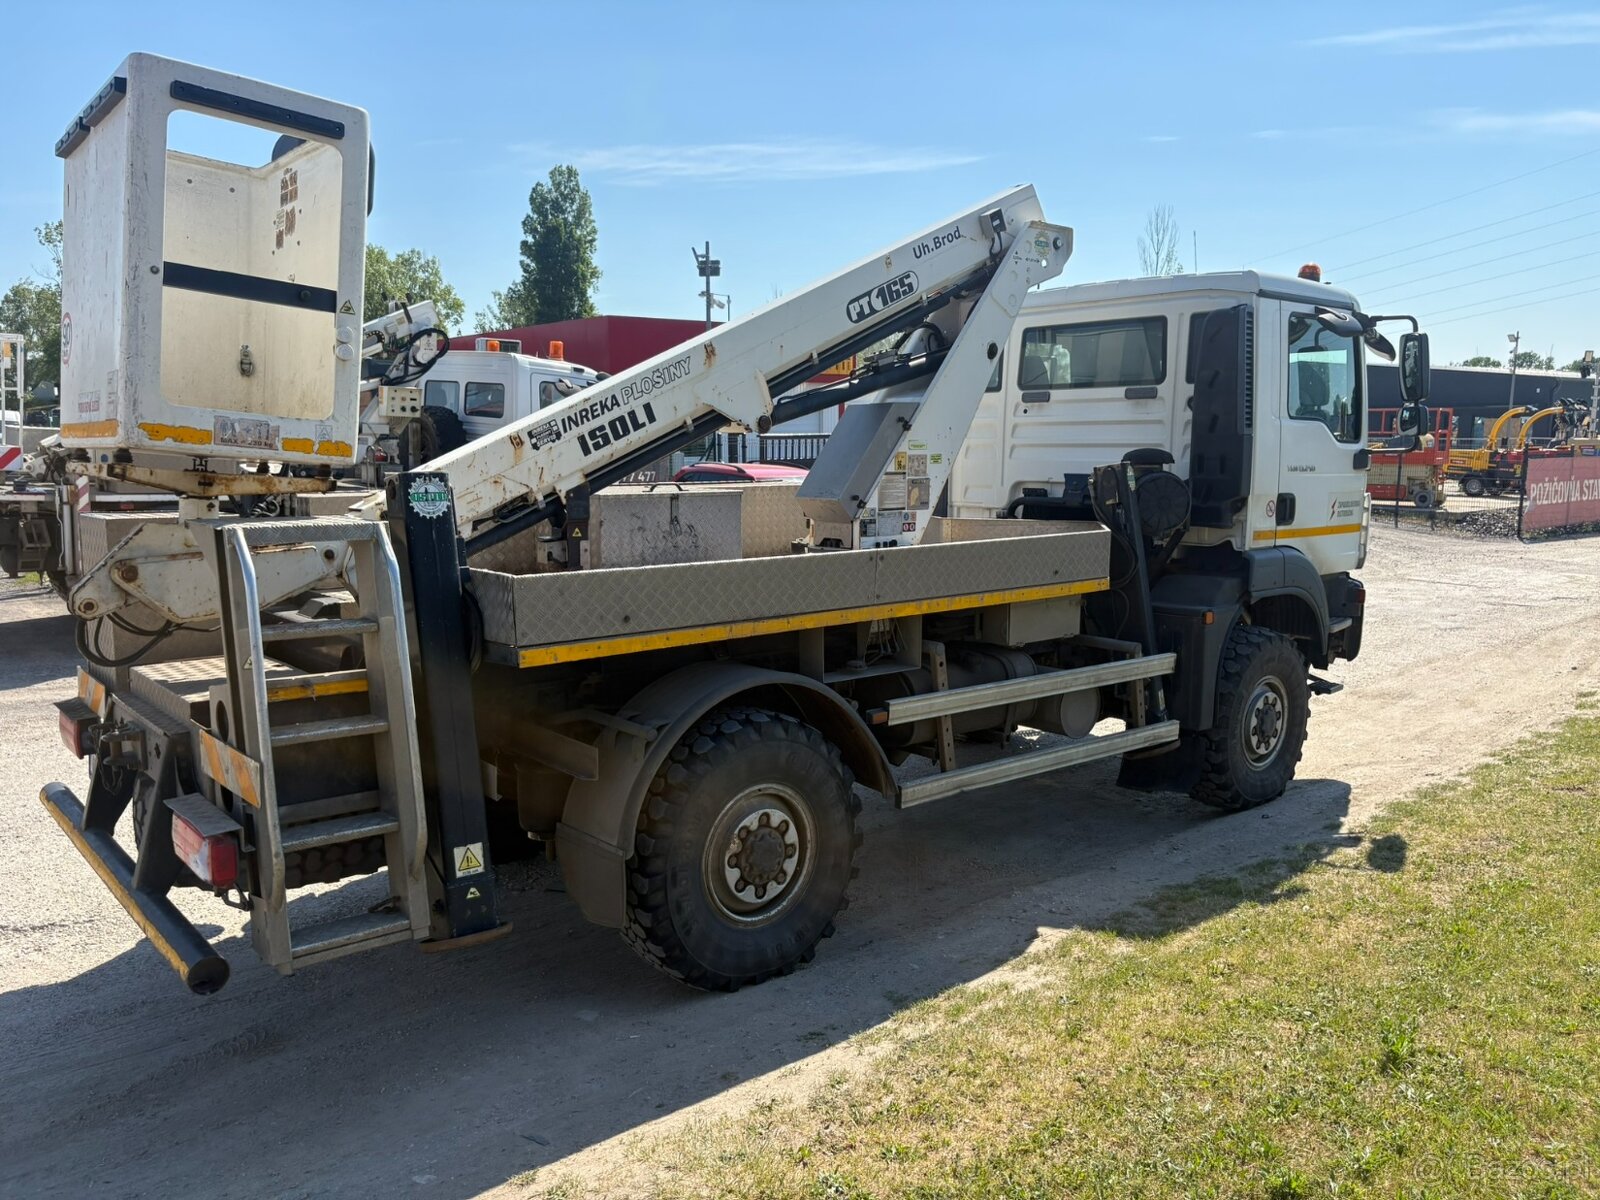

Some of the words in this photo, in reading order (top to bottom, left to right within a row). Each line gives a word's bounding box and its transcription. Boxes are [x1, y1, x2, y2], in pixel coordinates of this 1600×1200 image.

[912, 225, 961, 260] Uh.Brod
[560, 393, 621, 434] INREKA
[620, 355, 692, 405] PLOŠINY
[576, 401, 657, 457] ISOLI
